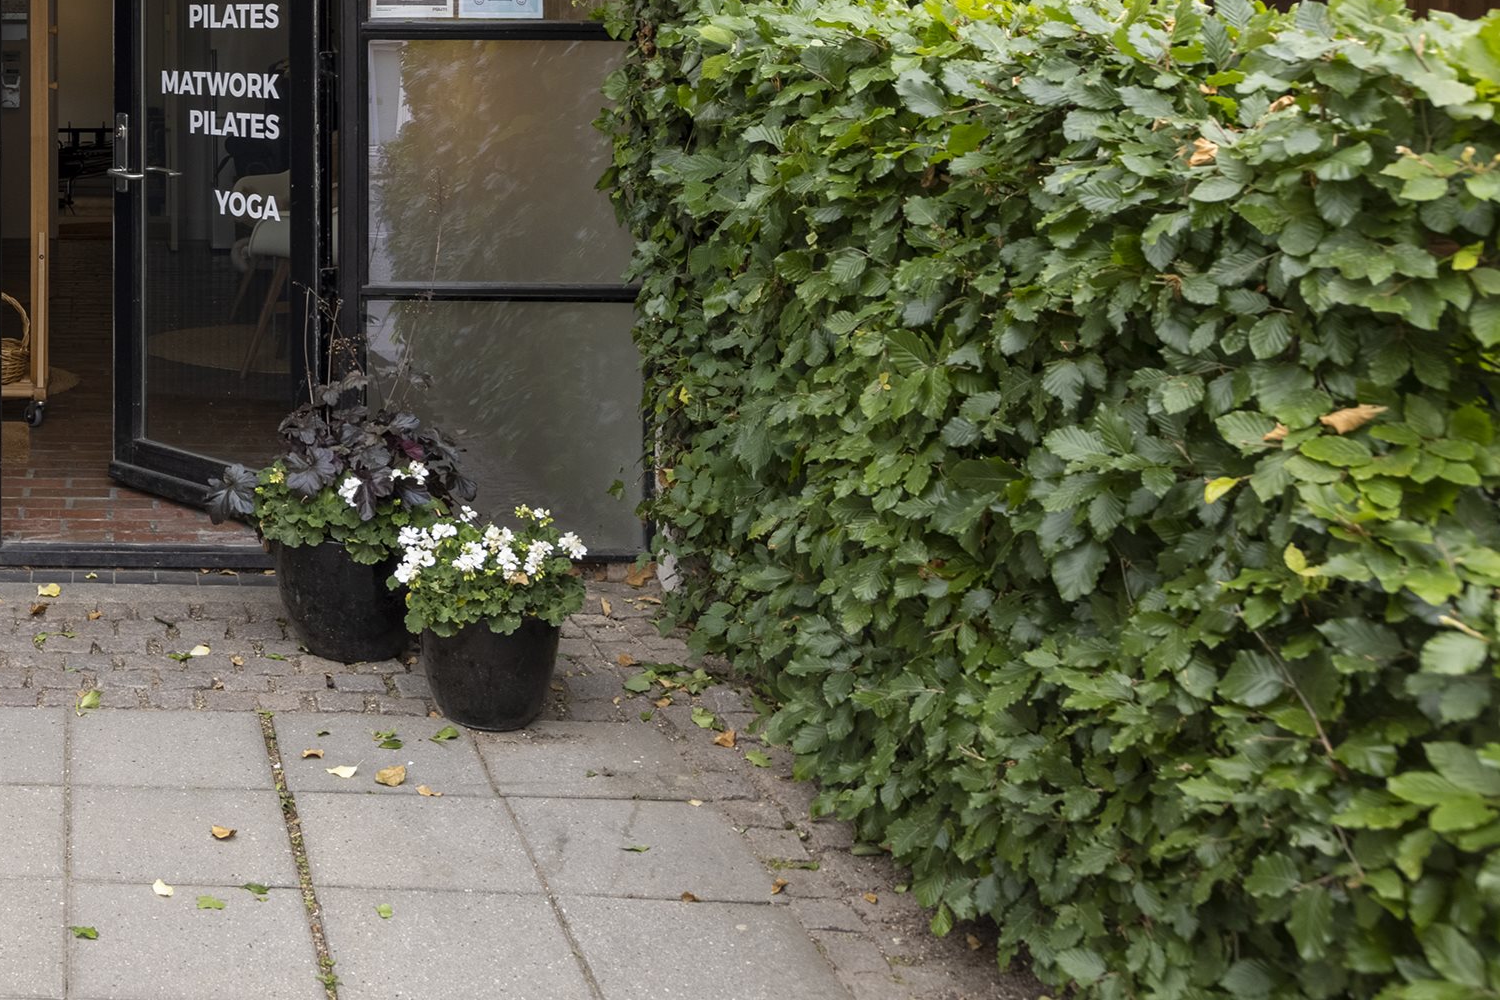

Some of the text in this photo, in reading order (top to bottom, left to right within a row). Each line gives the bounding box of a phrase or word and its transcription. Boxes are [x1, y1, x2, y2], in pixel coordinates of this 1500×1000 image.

[188, 3, 280, 29] PILATES
[160, 70, 280, 100] MATWORK
[188, 109, 280, 140] PILATES
[214, 188, 281, 222] YOGA
